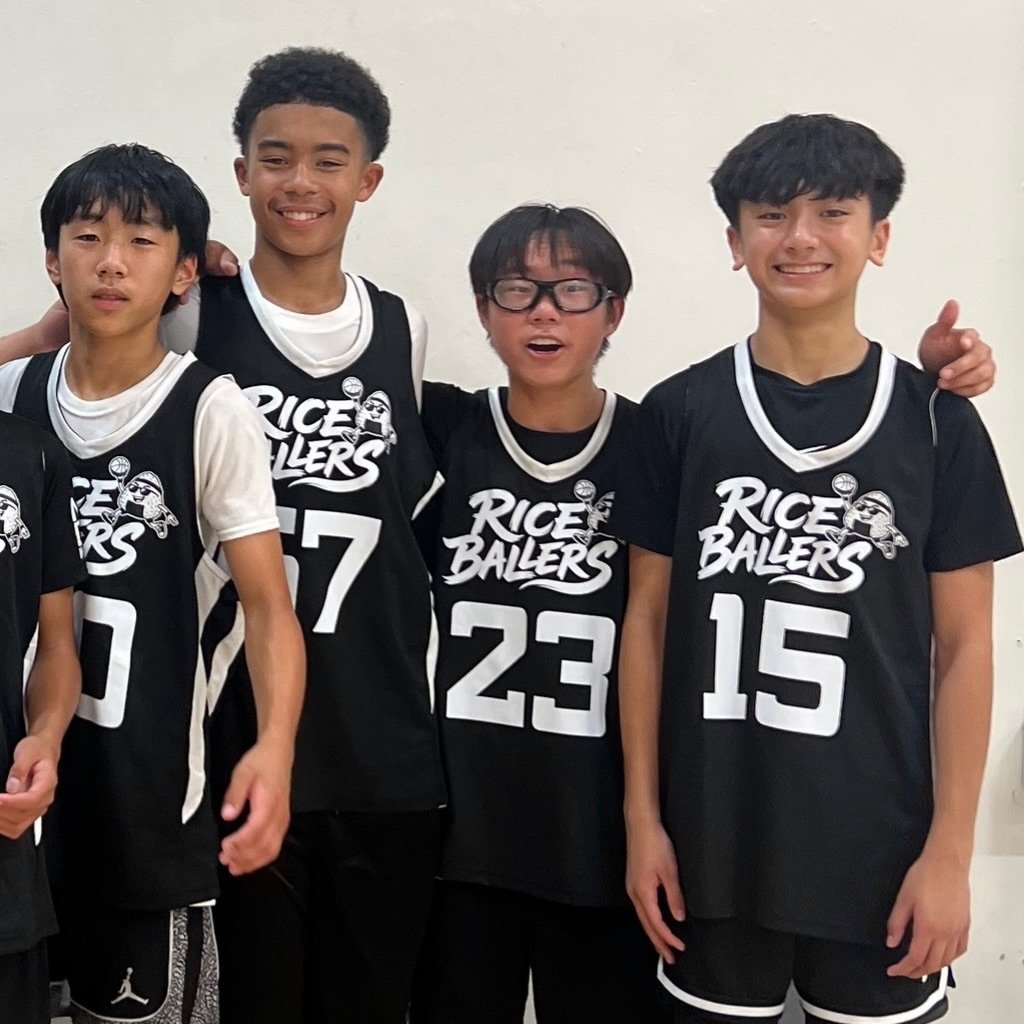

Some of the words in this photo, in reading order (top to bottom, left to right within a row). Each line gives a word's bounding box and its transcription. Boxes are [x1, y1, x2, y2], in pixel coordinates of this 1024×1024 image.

[270, 433, 385, 492] LLERS
[469, 489, 582, 541] RICE
[715, 477, 844, 534] RICE
[277, 505, 382, 633] 7
[442, 534, 616, 594] BALLERS
[698, 525, 872, 593] BALLERS
[73, 592, 137, 728] 0
[446, 601, 616, 737] 23
[703, 593, 851, 737] 15
